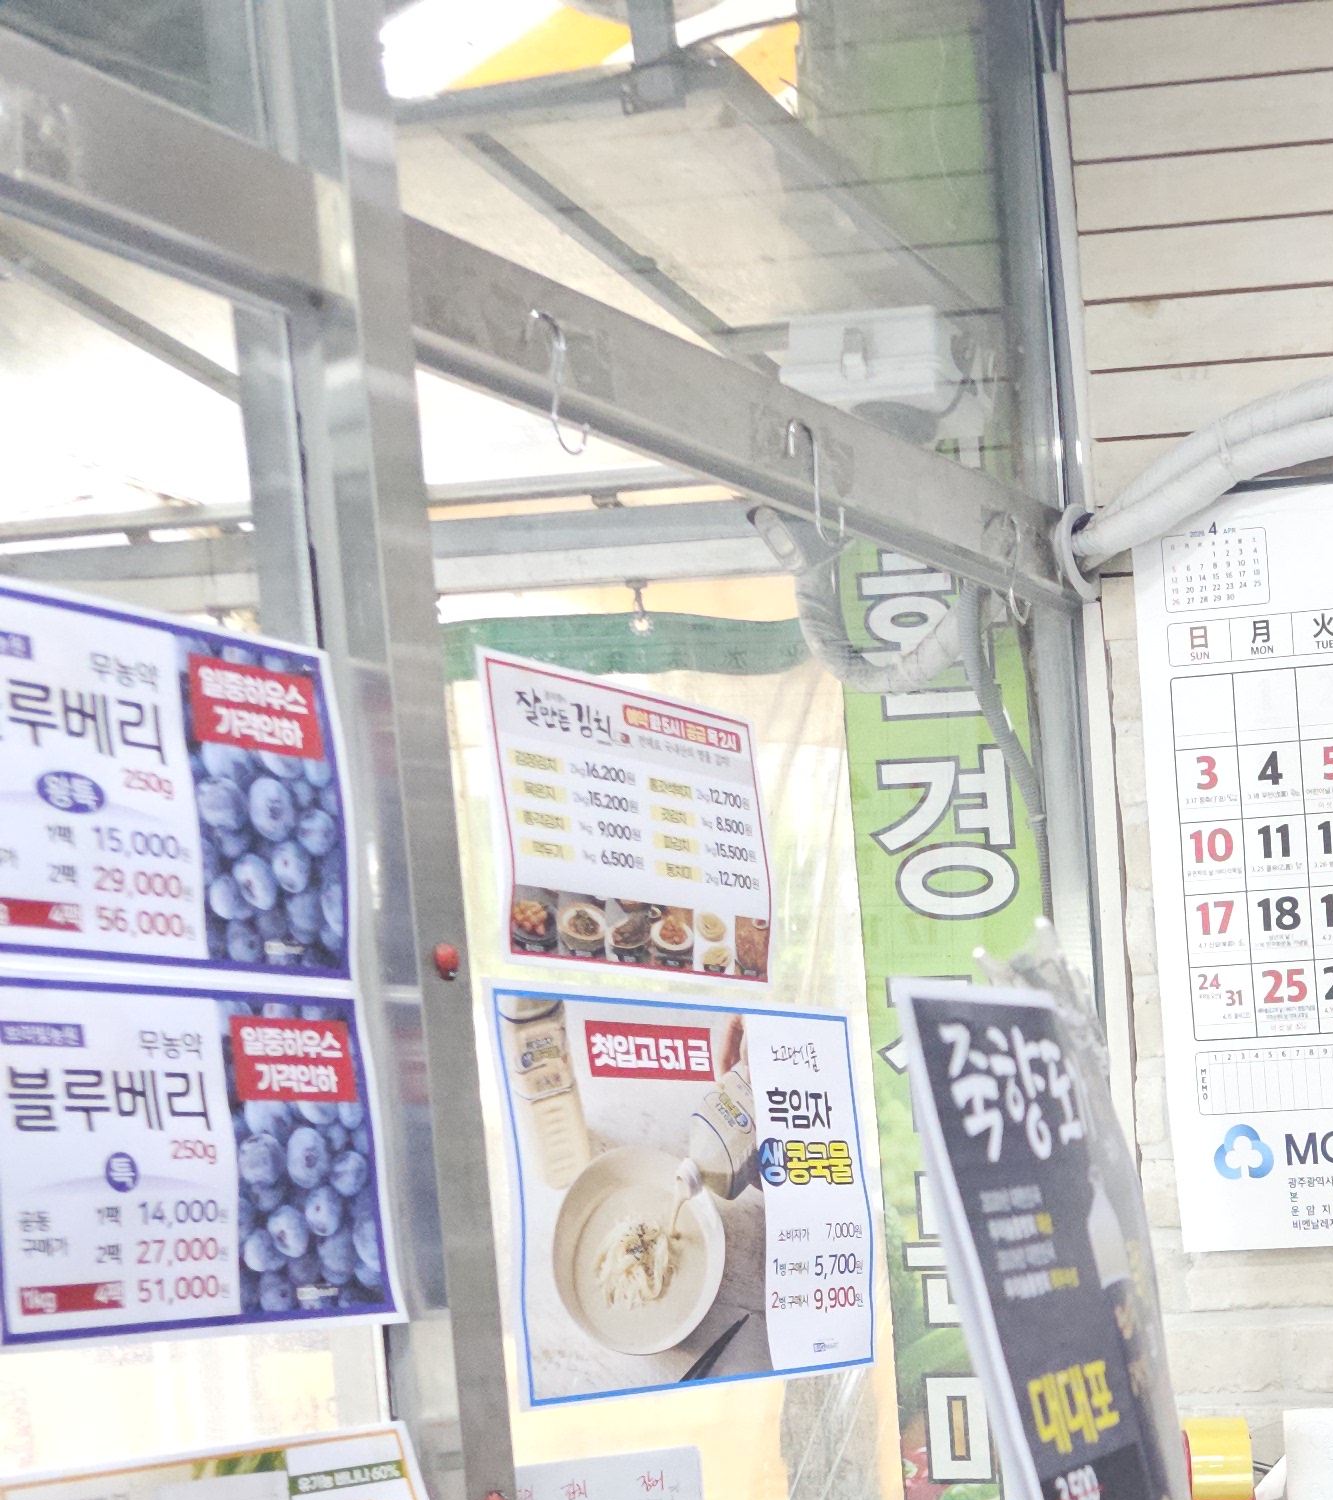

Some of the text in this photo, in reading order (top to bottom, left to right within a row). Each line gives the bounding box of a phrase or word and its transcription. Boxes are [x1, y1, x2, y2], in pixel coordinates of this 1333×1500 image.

[1188, 626, 1209, 652] 日
[1250, 619, 1272, 645] 月
[90, 652, 159, 692] 무농약
[0, 678, 167, 765] 루베리
[122, 767, 174, 801] 250g
[1196, 755, 1219, 791] 3
[1257, 750, 1283, 786] 4
[1189, 827, 1234, 864] 10
[1257, 823, 1291, 859] 11
[1195, 899, 1235, 936] 17
[1256, 895, 1302, 932] 18
[1261, 968, 1309, 1005] 25
[138, 1029, 204, 1060] 무농약
[590, 1032, 660, 1068] 첫입고
[254, 1063, 340, 1094] 가격인하
[7, 1065, 213, 1132] 블루베리
[766, 1086, 833, 1129] 흑임자
[759, 1138, 855, 1187] 생콩국물
[777, 1228, 810, 1243] 소비자가
[813, 1253, 864, 1281] 5,700원
[813, 1286, 865, 1313] 9,900원
